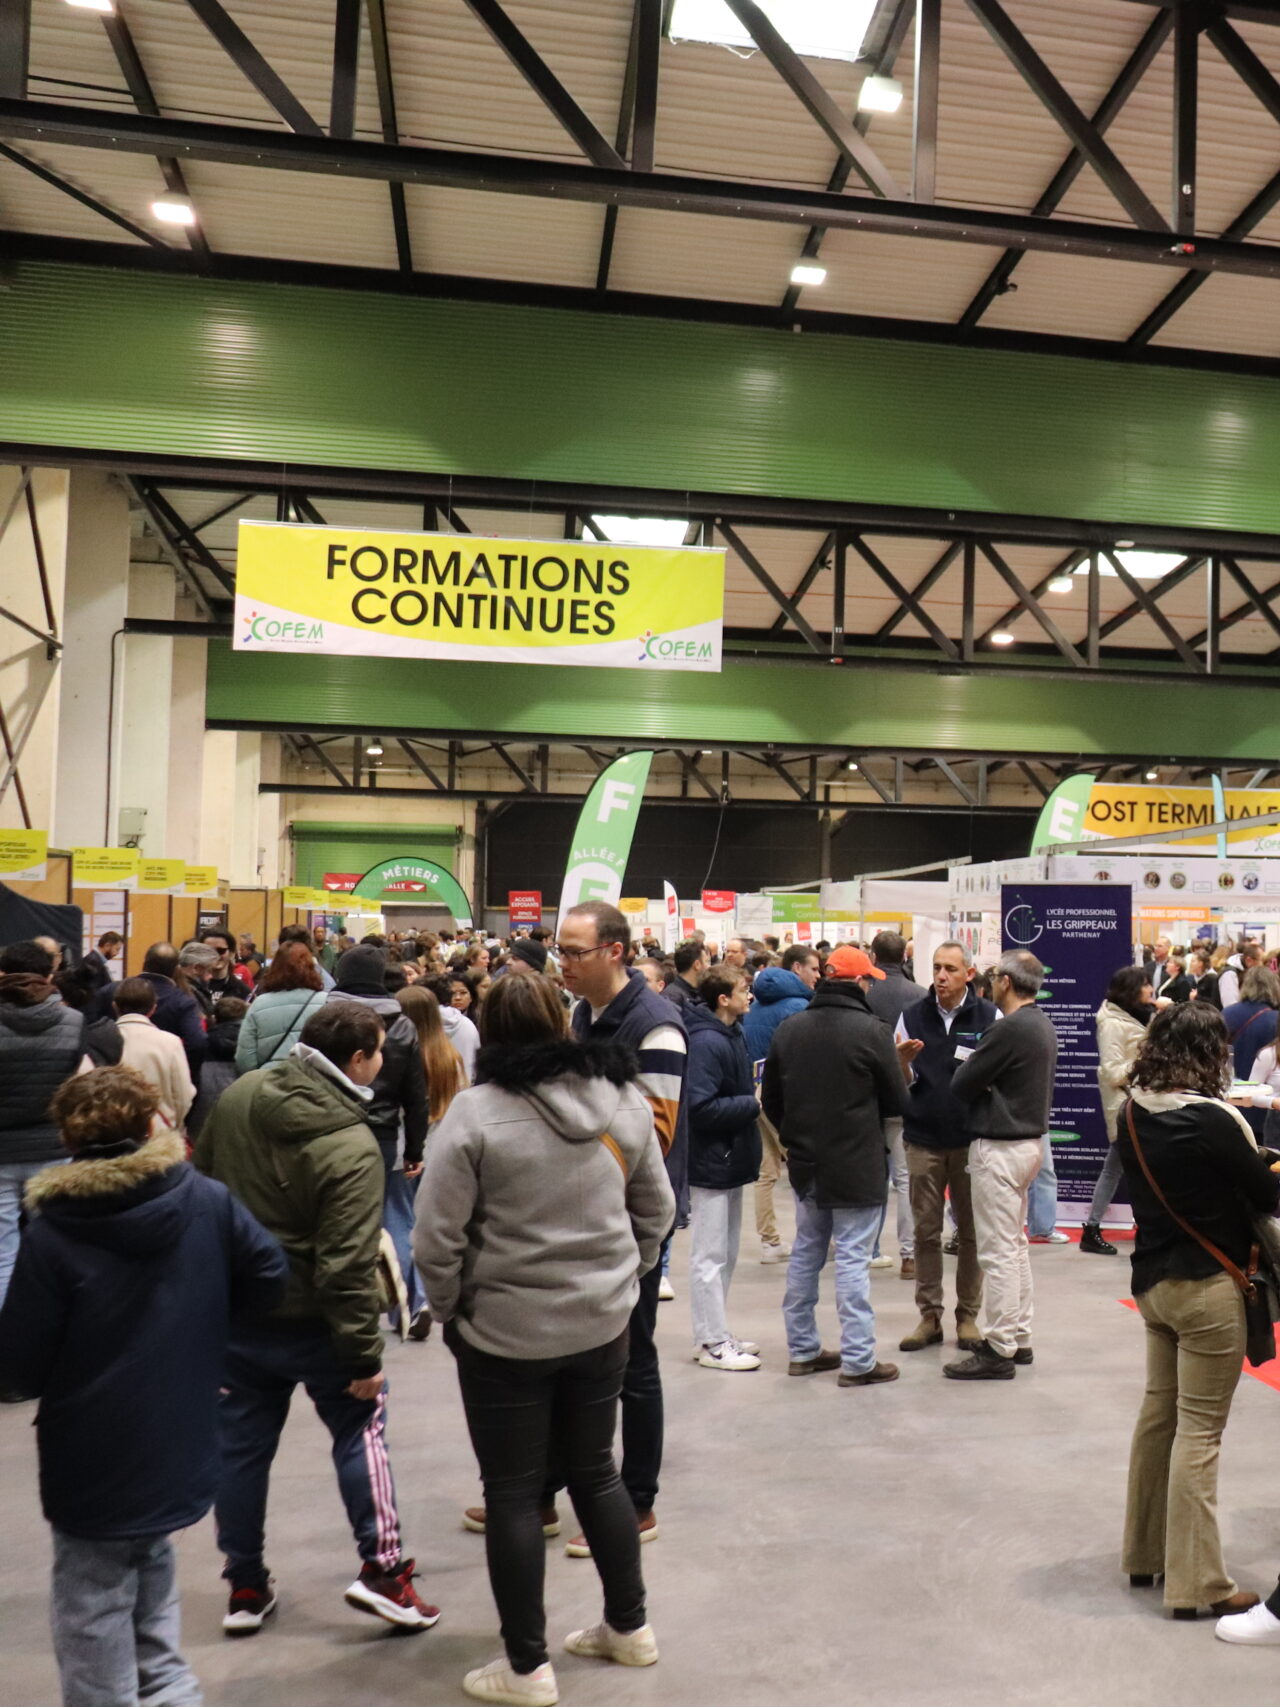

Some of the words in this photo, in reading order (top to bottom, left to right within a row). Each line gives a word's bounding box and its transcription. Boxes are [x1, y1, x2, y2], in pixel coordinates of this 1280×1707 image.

[326, 544, 630, 596] FORMATIONS
[351, 588, 615, 637] CONTINUES
[597, 779, 636, 823] F
[1087, 800, 1138, 823] OST
[1145, 801, 1279, 827] TERMINAE
[1048, 796, 1079, 841] E
[574, 847, 616, 863] ALLÉE
[382, 864, 440, 885] MÉTIERS
[1046, 907, 1064, 917] LYCÉE
[1065, 908, 1118, 917] PROFESSIONNEL
[1046, 919, 1062, 930] LES
[1064, 919, 1118, 931] GRIPPEAUX
